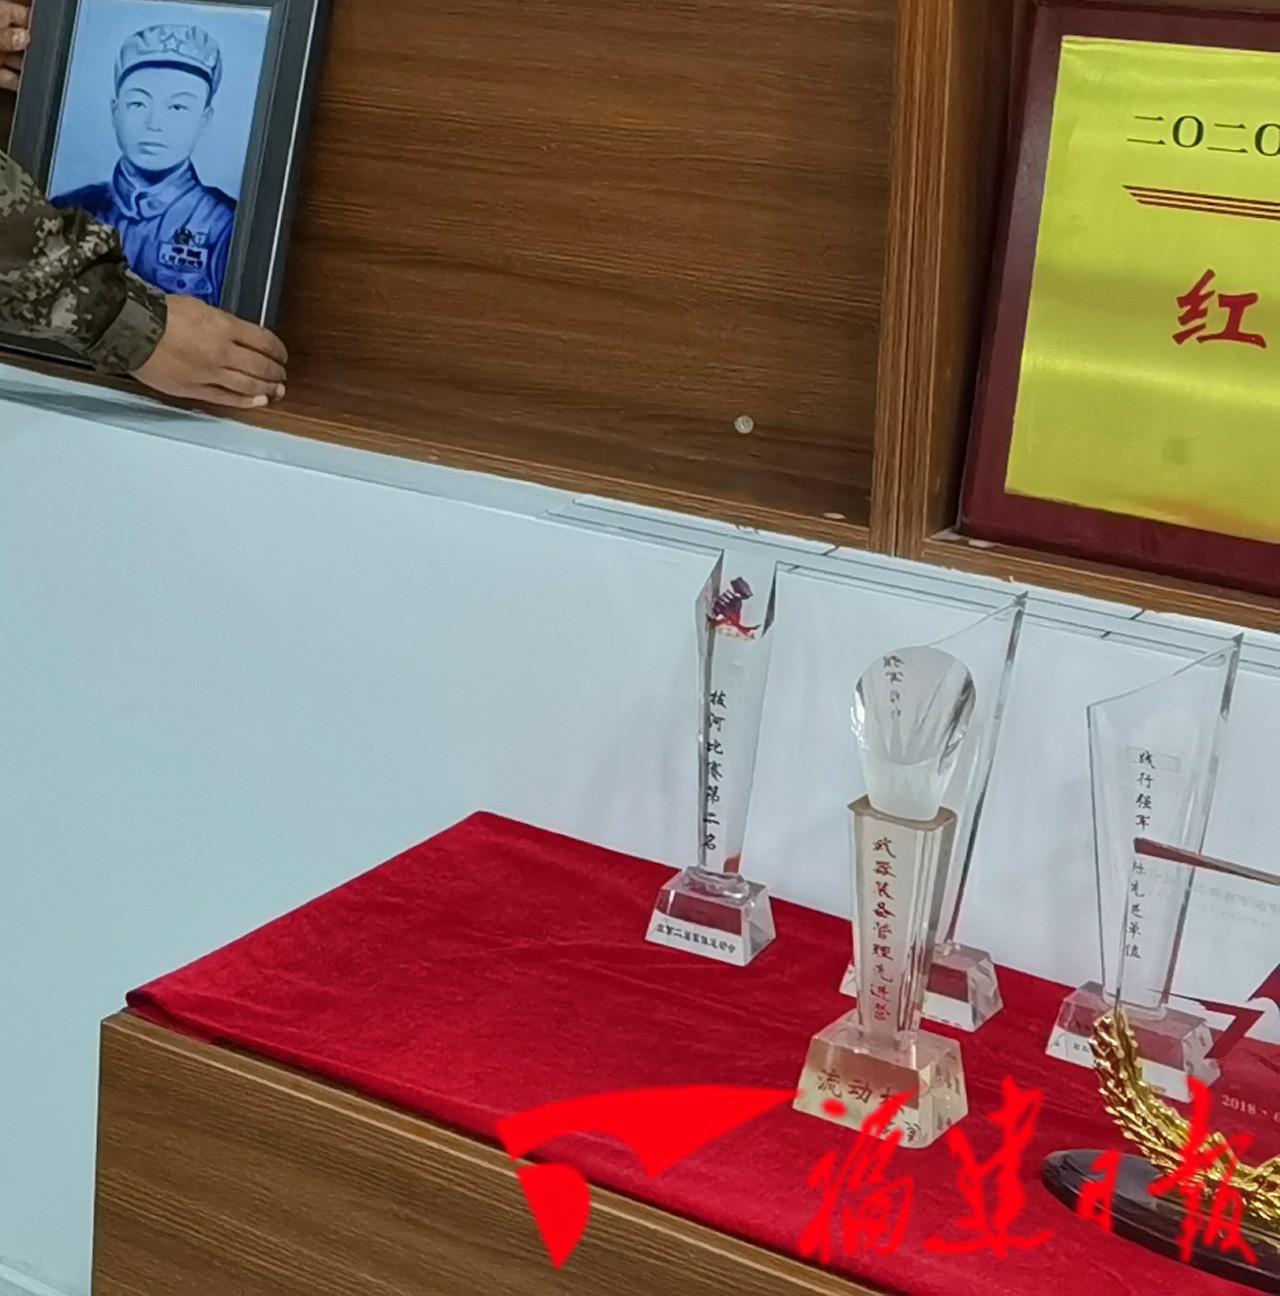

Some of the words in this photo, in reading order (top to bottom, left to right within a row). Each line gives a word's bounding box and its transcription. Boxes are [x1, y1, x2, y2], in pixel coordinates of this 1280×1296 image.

[1171, 268, 1267, 349] 红
[702, 689, 728, 851] 拔河比赛第二名
